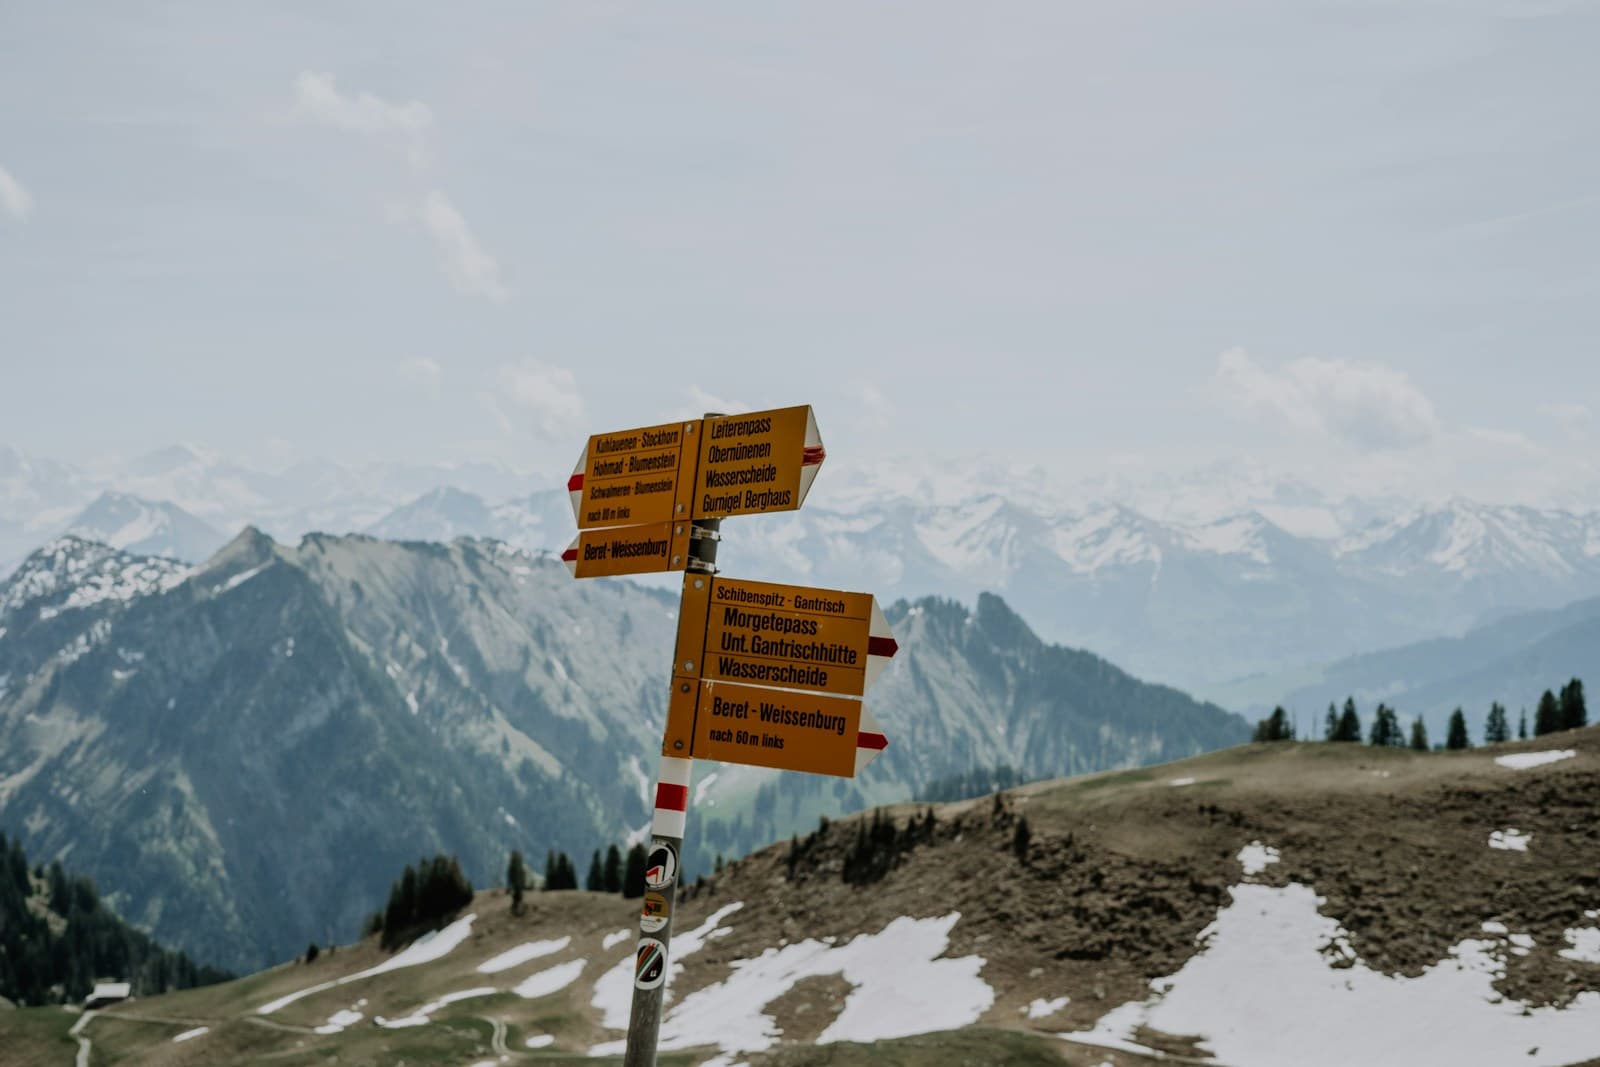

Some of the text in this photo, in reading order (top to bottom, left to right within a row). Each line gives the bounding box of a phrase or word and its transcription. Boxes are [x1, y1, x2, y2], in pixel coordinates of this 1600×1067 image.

[642, 429, 678, 448] Stockhorn
[711, 417, 771, 439] Leiterenpass
[708, 442, 771, 463] Obernünenen
[705, 465, 777, 488] Wasserscheide
[703, 489, 791, 513] Gurnigel Berghaus
[611, 538, 668, 558] Weissenburg
[717, 586, 785, 607] Schibenspitz
[794, 595, 845, 614] Gantrisch
[723, 607, 818, 636] Morgetepass
[721, 632, 857, 665] Unt. Gantrischhütte
[719, 656, 828, 687] Wasserscheide
[712, 696, 748, 720] Beret
[760, 702, 846, 736] Weissenburg
[709, 728, 733, 744] nach
[762, 734, 785, 749] links
